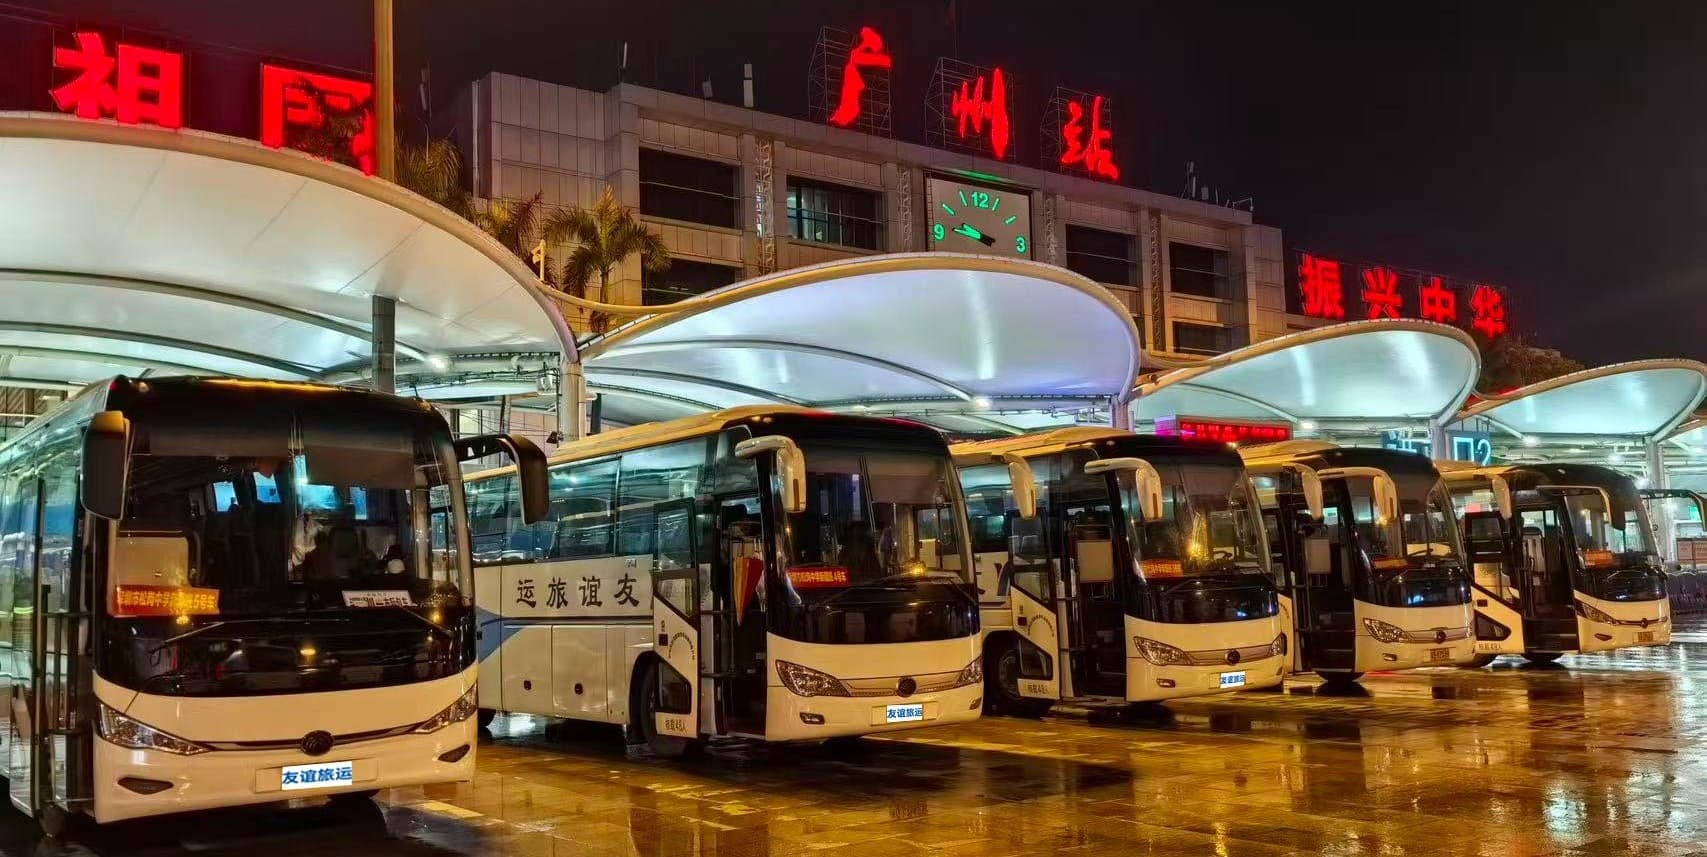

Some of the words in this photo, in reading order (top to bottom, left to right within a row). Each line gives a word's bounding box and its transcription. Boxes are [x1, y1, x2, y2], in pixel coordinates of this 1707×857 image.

[830, 26, 1119, 181] 广州站
[971, 191, 989, 209] 12
[933, 223, 945, 240] 9
[1016, 236, 1026, 253] 3
[1300, 254, 1506, 337] 振兴中华
[888, 707, 923, 718] 友谊旅运
[282, 767, 352, 784] 友谊旅运
